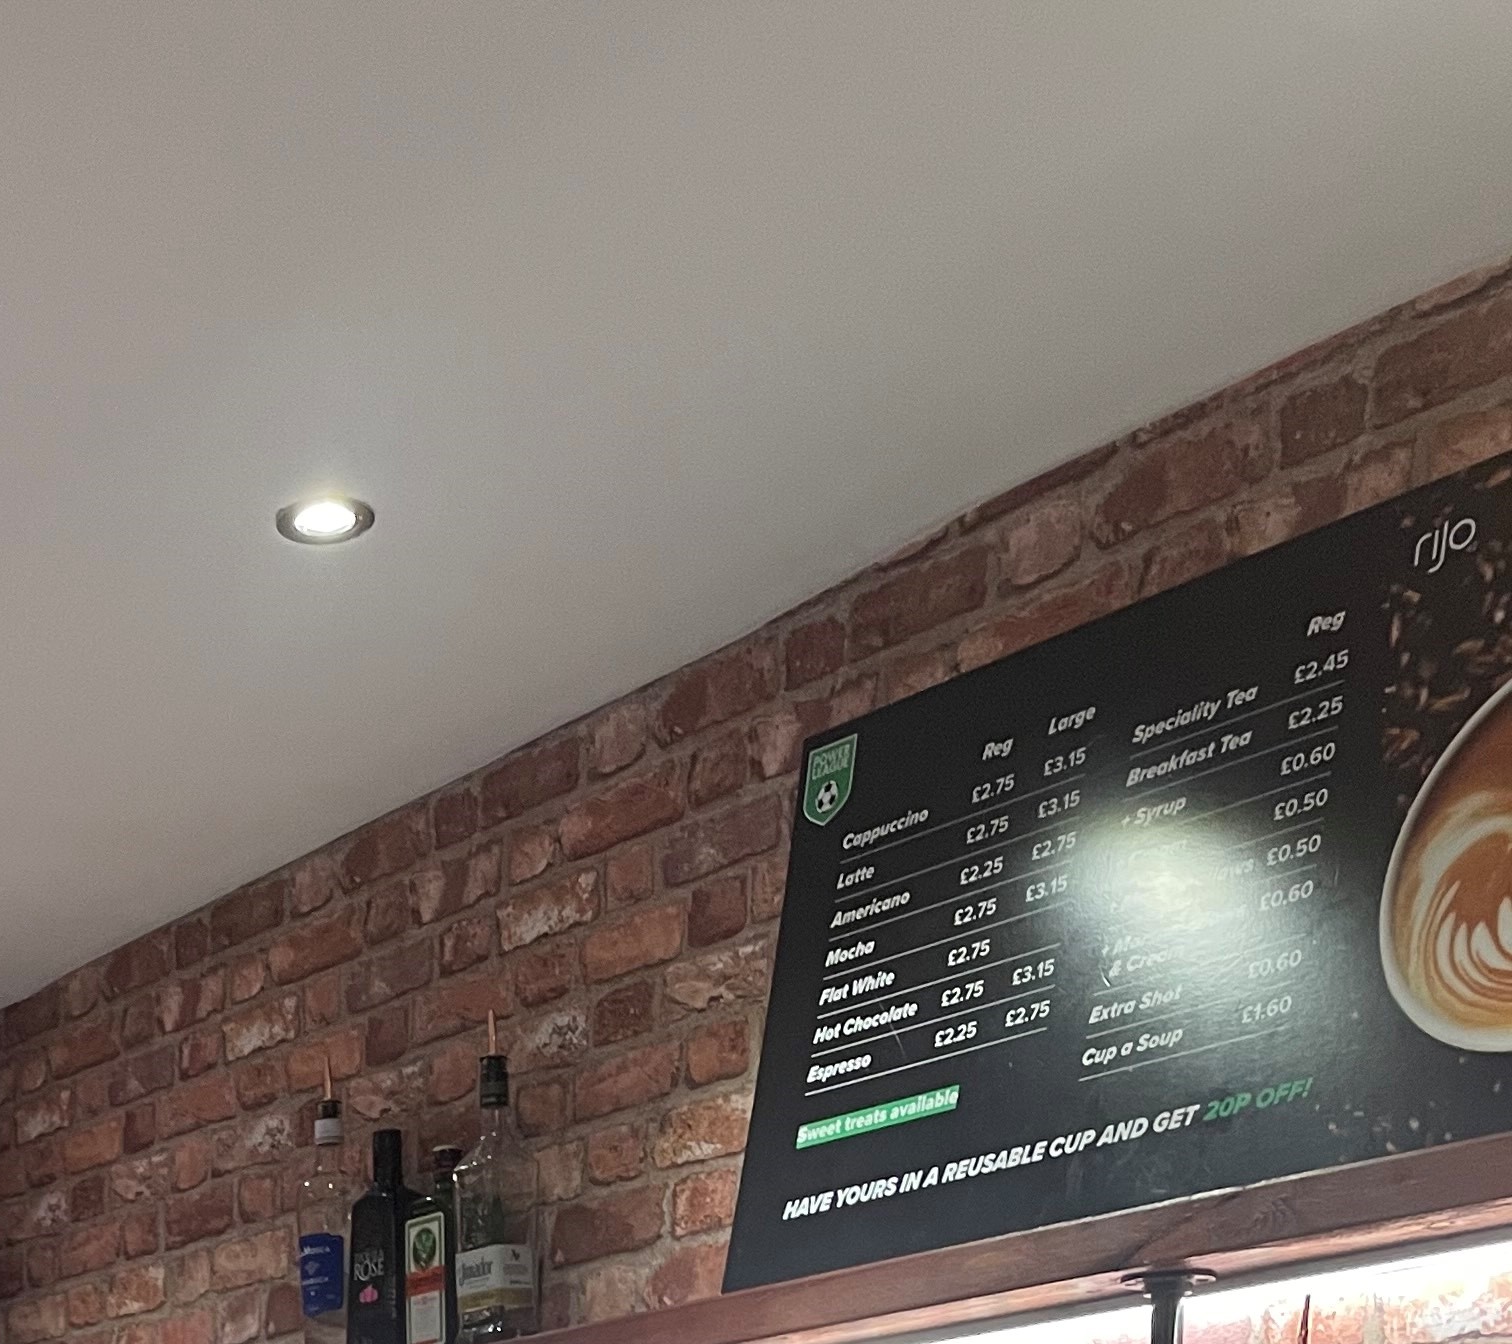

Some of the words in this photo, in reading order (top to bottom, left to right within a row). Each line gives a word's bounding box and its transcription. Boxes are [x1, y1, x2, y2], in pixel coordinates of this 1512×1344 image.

[1413, 518, 1477, 574] rijo
[1306, 610, 1347, 637] Reg
[981, 737, 1014, 761] Reg
[1047, 705, 1097, 736] Large
[1131, 699, 1222, 745] Speciality
[1225, 685, 1259, 711] Tea
[1293, 649, 1350, 685] £2.45
[1125, 741, 1216, 788] Breakfast
[1220, 730, 1254, 754] Tea
[1287, 695, 1344, 730] £2.25
[841, 807, 930, 851] Cappuccino
[971, 773, 1016, 804] £2.75
[1043, 746, 1087, 777] £3.15
[1133, 796, 1187, 828] Syrup
[1279, 741, 1337, 776] £0.60
[1272, 787, 1329, 821] £0.50
[836, 864, 876, 890] Latte
[965, 814, 1010, 845] £2.75
[1037, 789, 1081, 819] £3.15
[1265, 833, 1323, 866] £0.50
[829, 890, 911, 929] Americano
[959, 855, 1005, 886] £2.25
[1031, 831, 1078, 861] £2.75
[1258, 880, 1315, 912] £0.60
[824, 938, 876, 968] Mocha
[952, 897, 998, 927] £2.75
[1025, 874, 1069, 903] £3.15
[812, 1021, 842, 1045] Hot
[842, 1001, 919, 1036] Chocolate
[940, 979, 985, 1008] £2.75
[1011, 958, 1056, 986] £3.15
[818, 982, 850, 1007] Flat
[851, 970, 896, 997] White
[946, 938, 991, 967] £2.75
[1087, 998, 1137, 1027] Extra
[1138, 983, 1184, 1010] Shot
[805, 1053, 873, 1084] Espresso
[933, 1020, 979, 1049] £2.25
[1004, 999, 1051, 1028] £2.75
[1081, 1045, 1118, 1068] Cup
[1136, 1028, 1184, 1054] Soup
[1240, 995, 1293, 1025] £1.60
[781, 1190, 835, 1222] HAVE
[835, 1175, 899, 1208] YOURS
[898, 1170, 925, 1194] IN
[921, 1166, 940, 1188] A
[940, 1139, 1049, 1185] REUSABLE
[1048, 1128, 1097, 1159] CUP
[1096, 1117, 1149, 1149] AND
[1151, 1103, 1201, 1134] GET
[1202, 1092, 1253, 1122] 20P
[1255, 1077, 1315, 1110] OFF!
[796, 1117, 842, 1145] Sweet
[844, 1105, 888, 1131] treats
[889, 1088, 960, 1121] available
